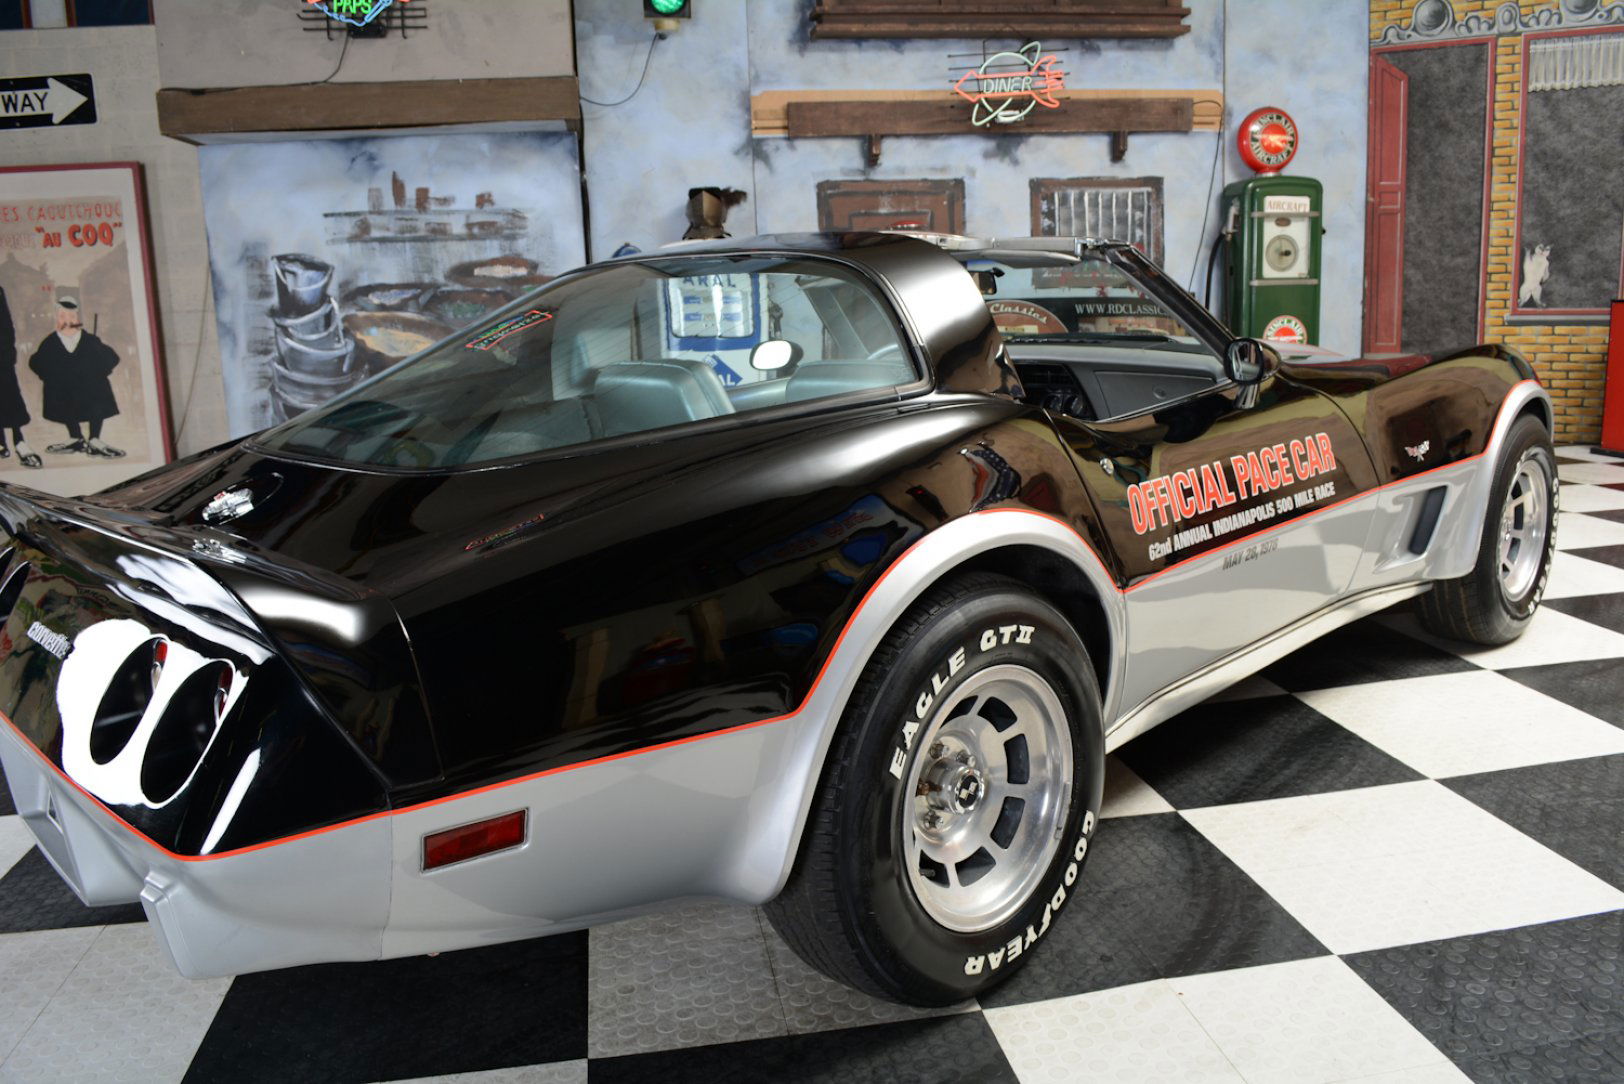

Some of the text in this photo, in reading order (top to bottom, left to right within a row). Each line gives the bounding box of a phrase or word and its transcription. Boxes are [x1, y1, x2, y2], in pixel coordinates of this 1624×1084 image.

[983, 76, 1033, 94] DINER
[2, 91, 48, 113] WAY
[1250, 141, 1296, 164] AIRCRAFT
[1267, 199, 1309, 212] AIRCRAFT
[1127, 432, 1337, 535] OFFICIAL PACE CAR
[1149, 482, 1335, 561] 62nd ANNUAL INDIANAPOLIS 500 MILE RACE
[1222, 552, 1244, 570] MAY
[889, 646, 966, 780] EAGLE
[964, 810, 1095, 976] GOODYEAR
